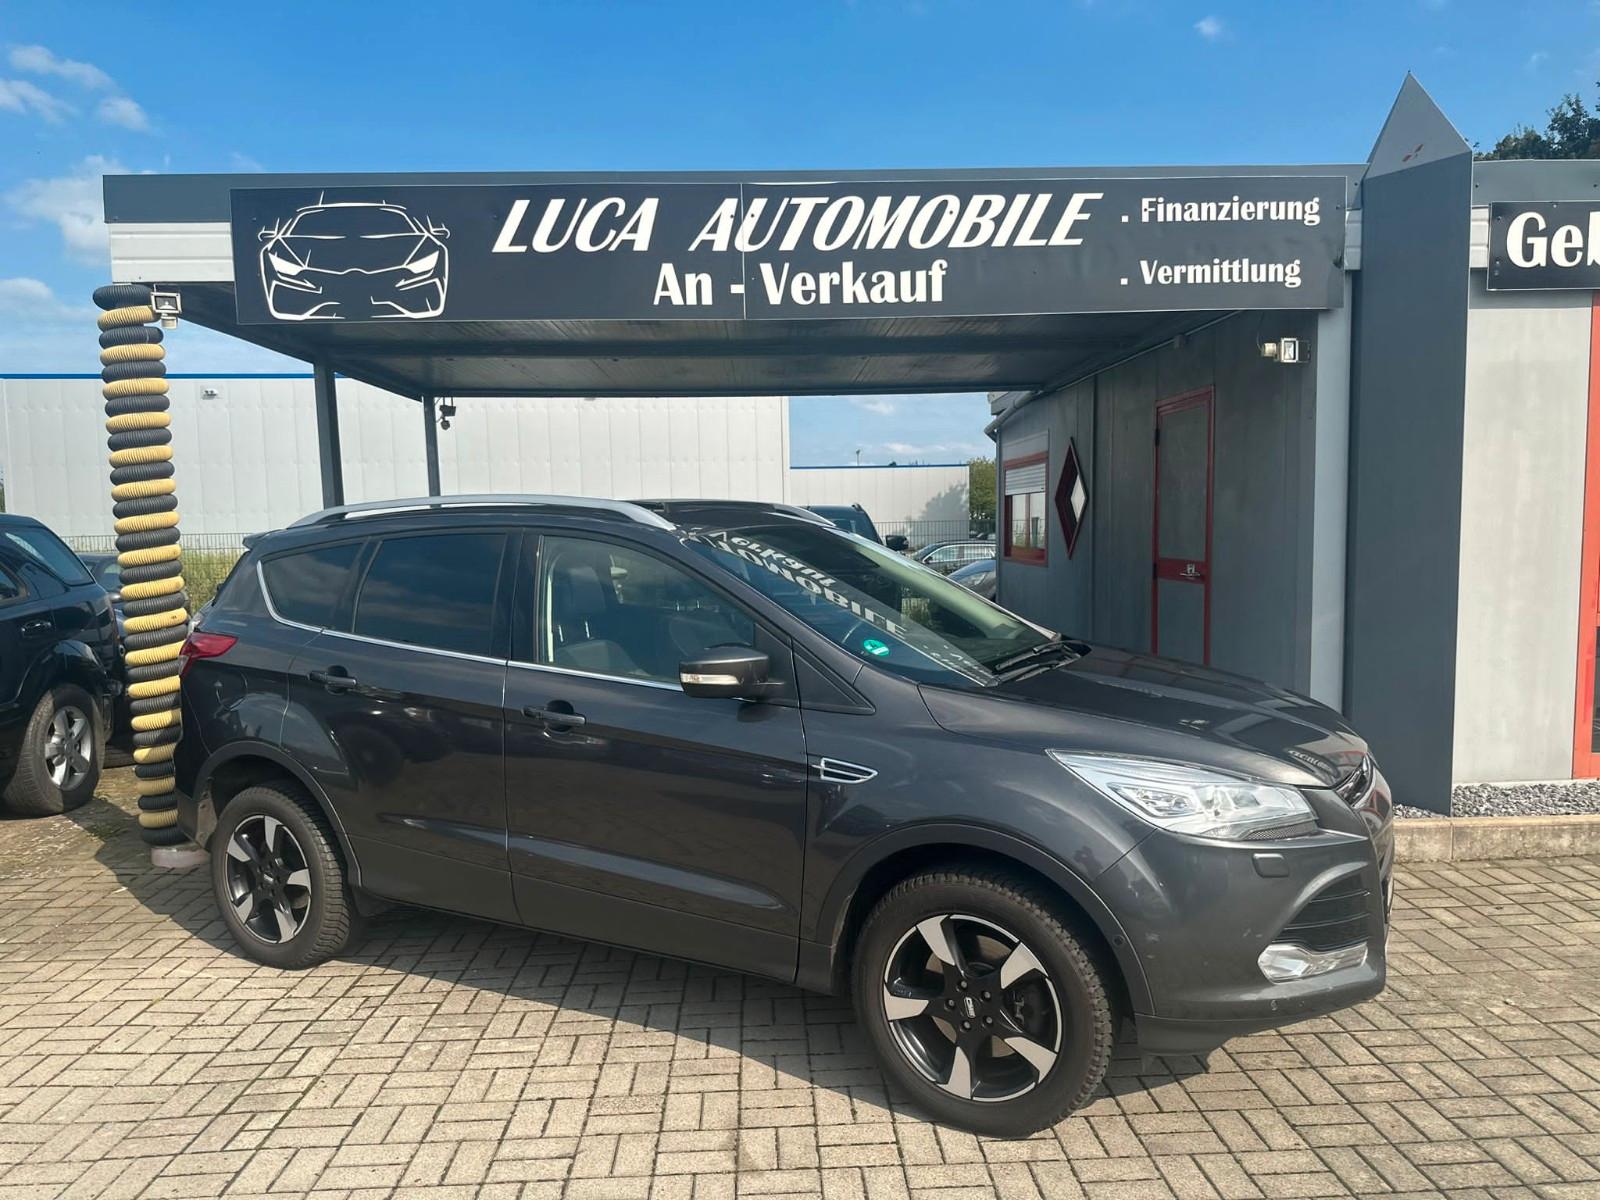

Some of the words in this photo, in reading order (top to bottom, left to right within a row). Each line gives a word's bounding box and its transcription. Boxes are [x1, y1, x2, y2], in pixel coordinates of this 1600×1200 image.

[492, 197, 659, 253] LUCA
[688, 192, 1103, 253] AUTOMOBILE
[1141, 196, 1320, 226] Finanzierung
[654, 262, 713, 306] An
[760, 259, 947, 305] Verkauf
[1140, 258, 1302, 288] Vermittlung
